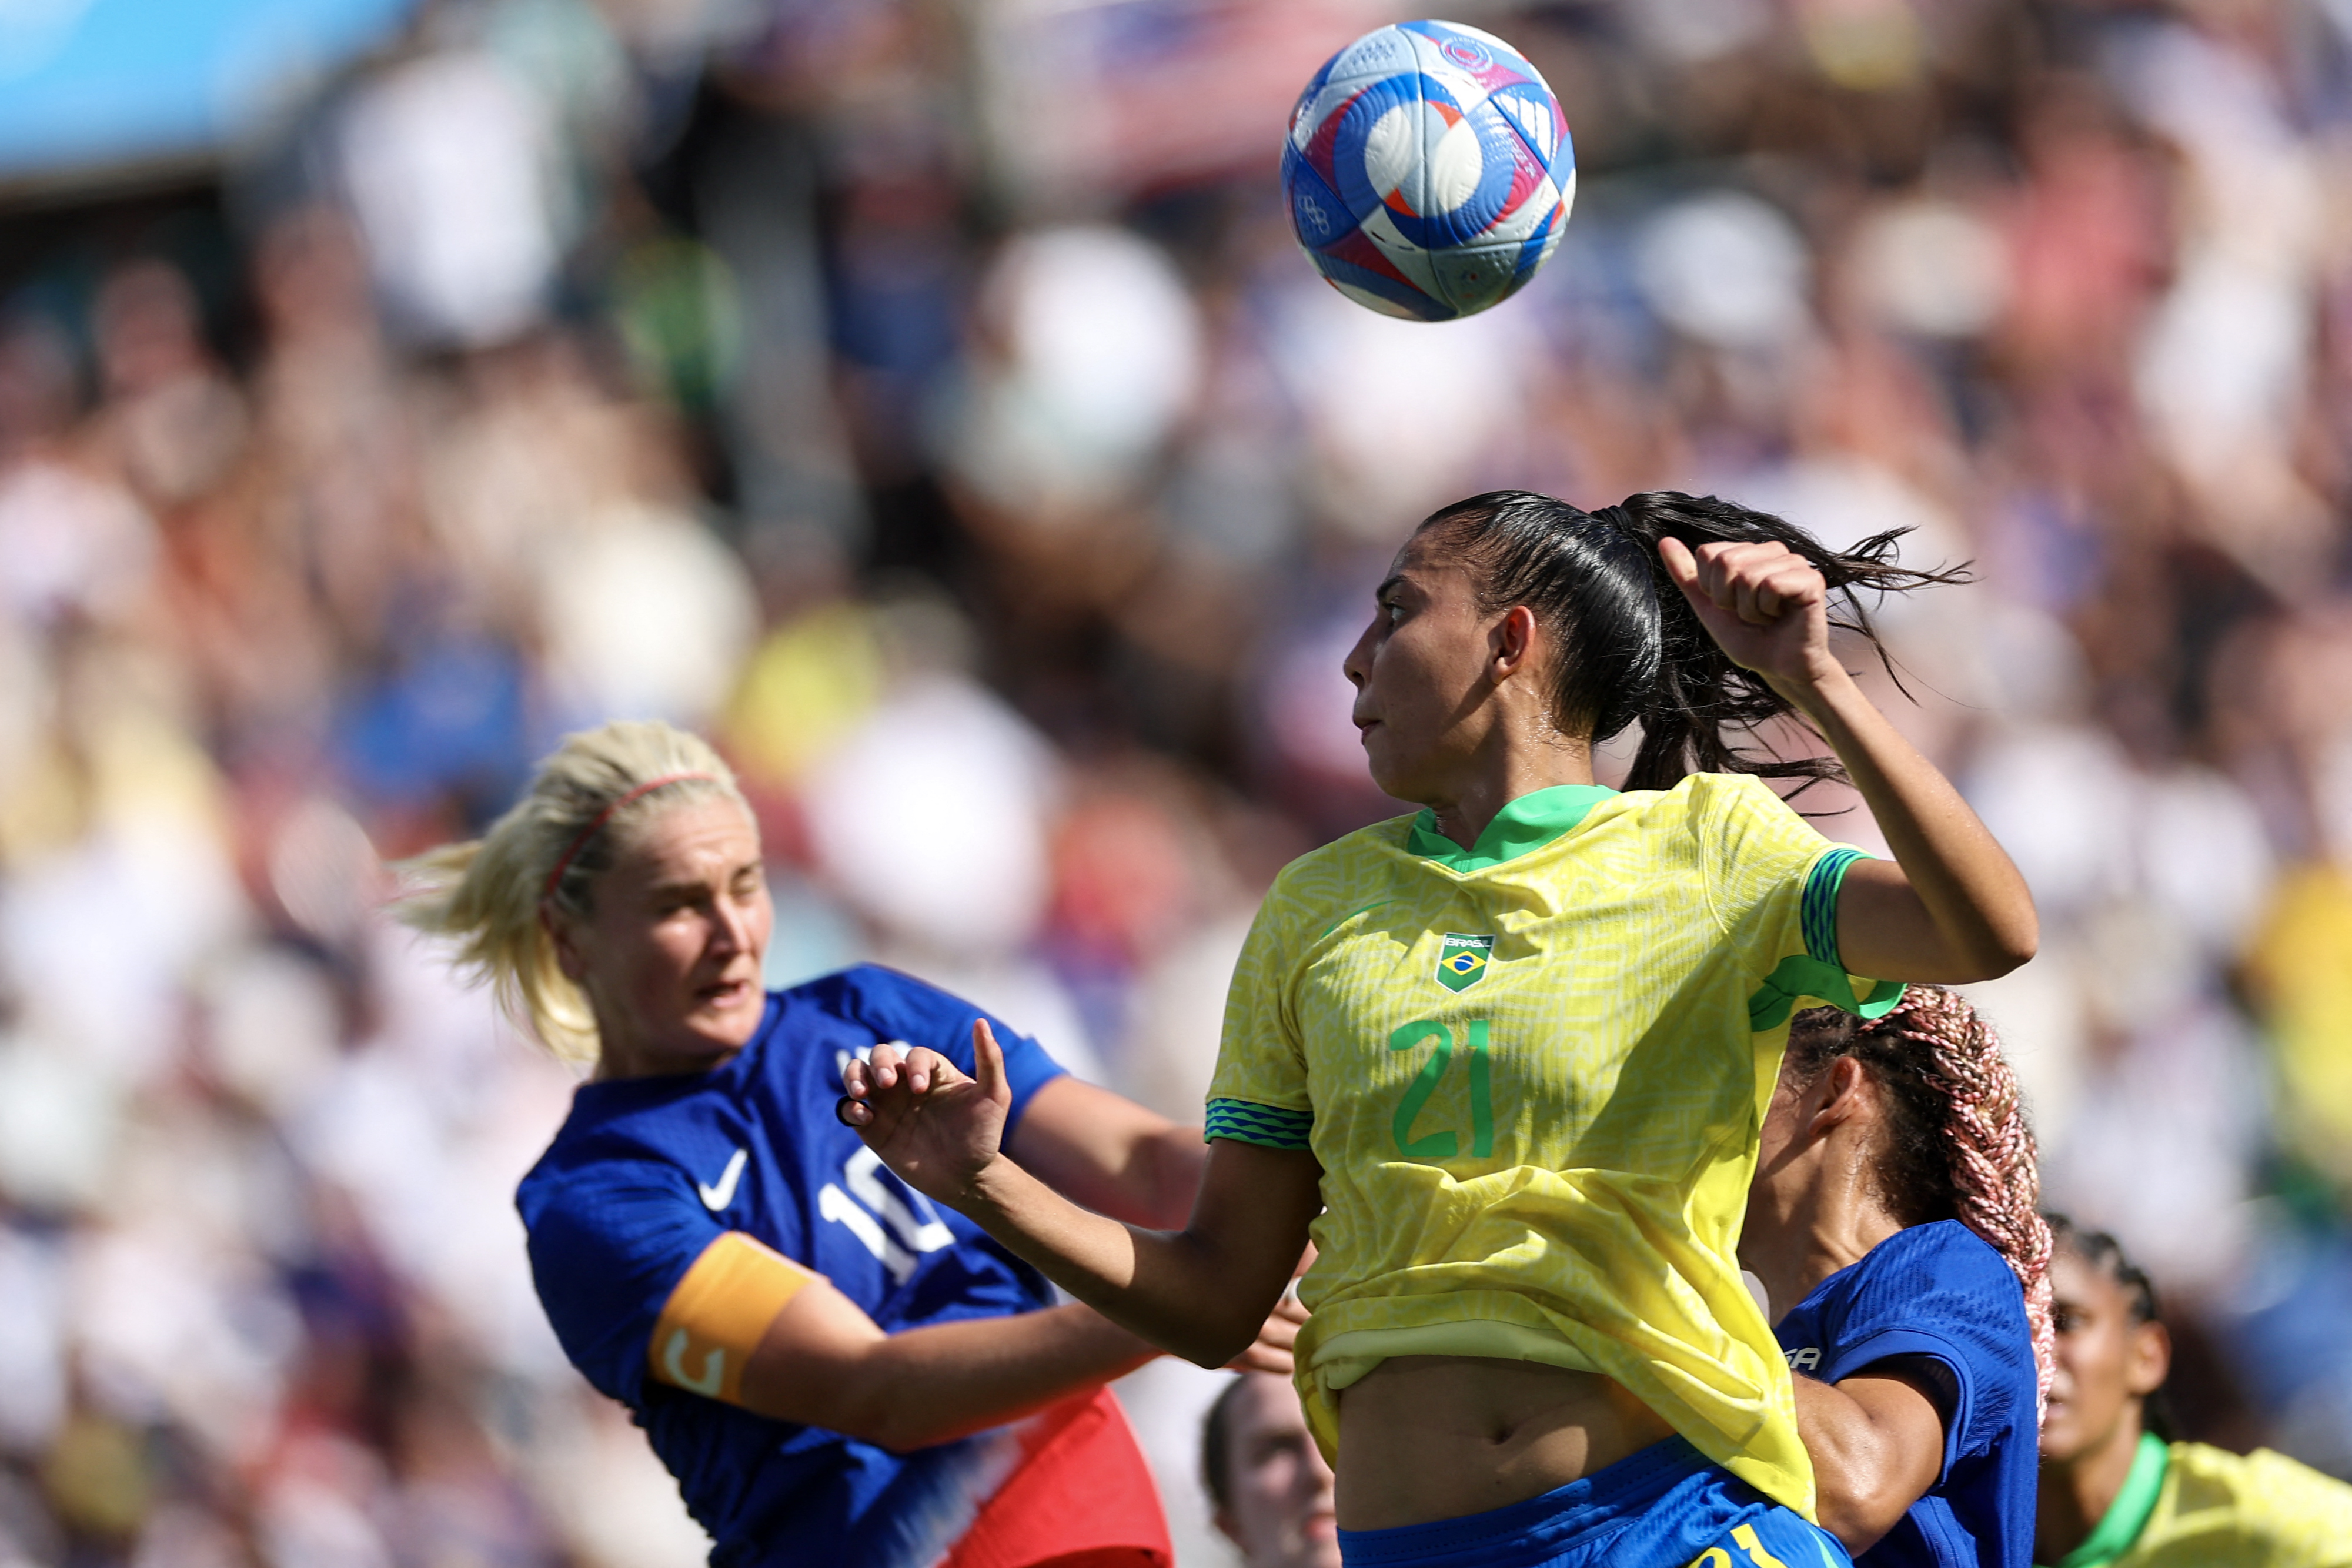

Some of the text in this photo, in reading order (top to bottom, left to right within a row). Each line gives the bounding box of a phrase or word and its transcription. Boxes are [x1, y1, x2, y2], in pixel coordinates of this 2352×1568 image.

[1445, 938, 1491, 948] BRASIL
[1390, 1020, 1494, 1158] 21
[818, 1144, 957, 1286] 10
